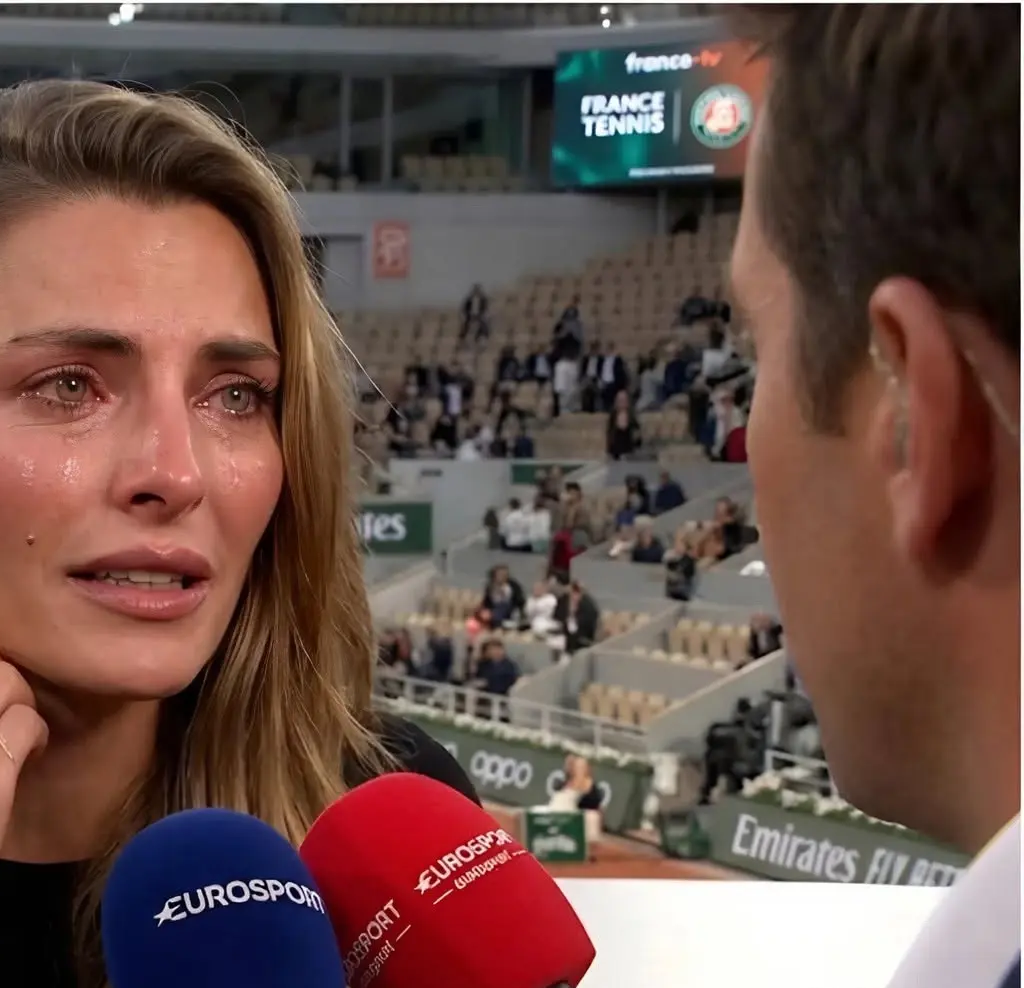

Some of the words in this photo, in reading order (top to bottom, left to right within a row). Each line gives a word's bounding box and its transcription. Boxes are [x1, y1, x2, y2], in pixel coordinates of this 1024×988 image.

[581, 91, 666, 115] FRANCE
[581, 112, 665, 137] TENNIS
[732, 813, 860, 884] Emirates
